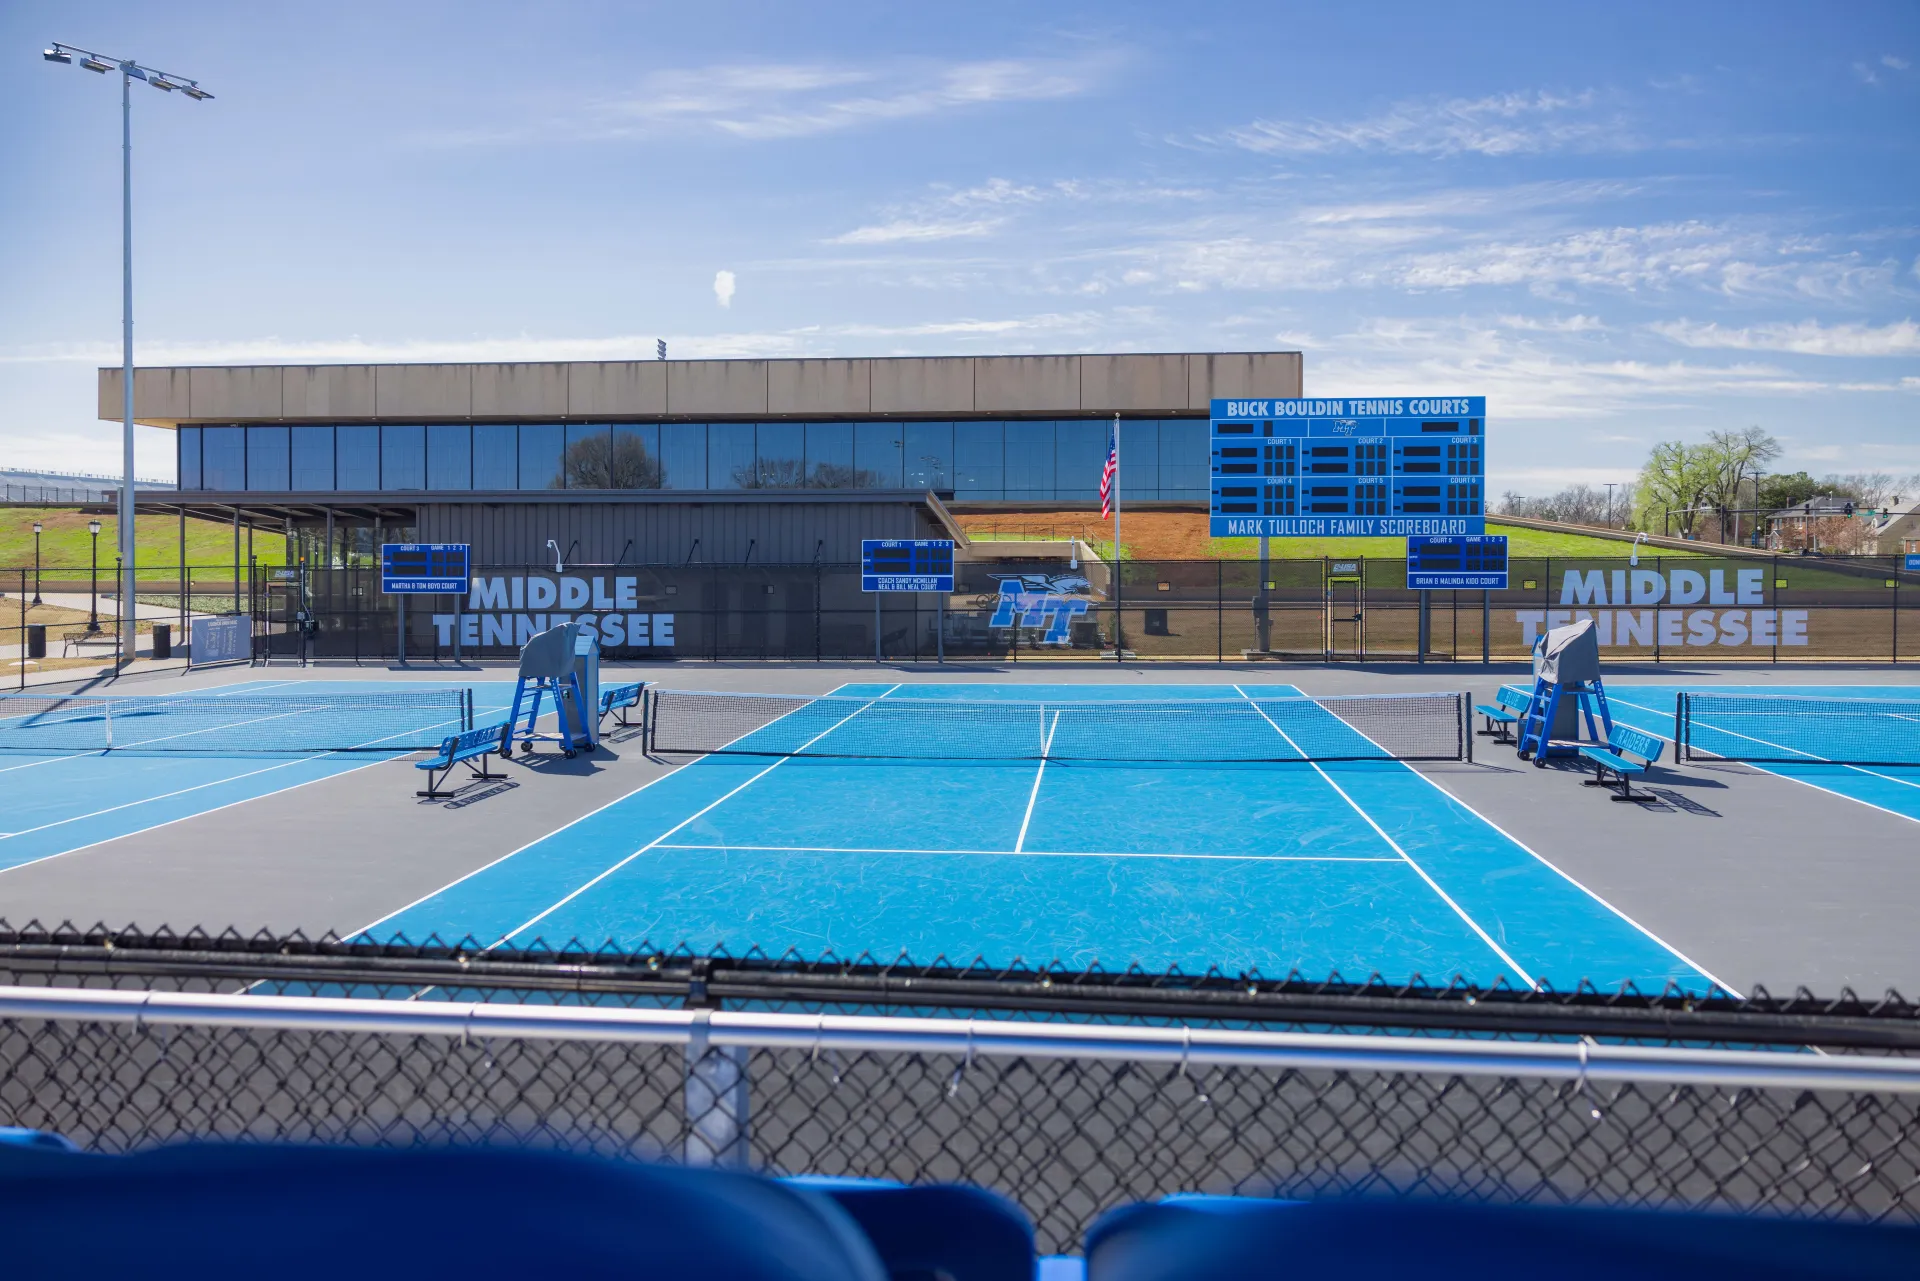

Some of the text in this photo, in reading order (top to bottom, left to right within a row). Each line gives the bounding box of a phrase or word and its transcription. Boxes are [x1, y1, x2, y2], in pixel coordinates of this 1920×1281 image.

[1227, 398, 1469, 416] BUCK BOULDIN TENNIS COURTS
[1228, 519, 1466, 535] MARK TULLOCH FAMILY SCOREBOARD
[469, 577, 638, 609] MIDDLE
[1560, 569, 1764, 605] MIDDLE
[988, 579, 1089, 644] MT
[432, 614, 675, 647] TENNSSEE
[1617, 729, 1650, 754] RAIDERS
